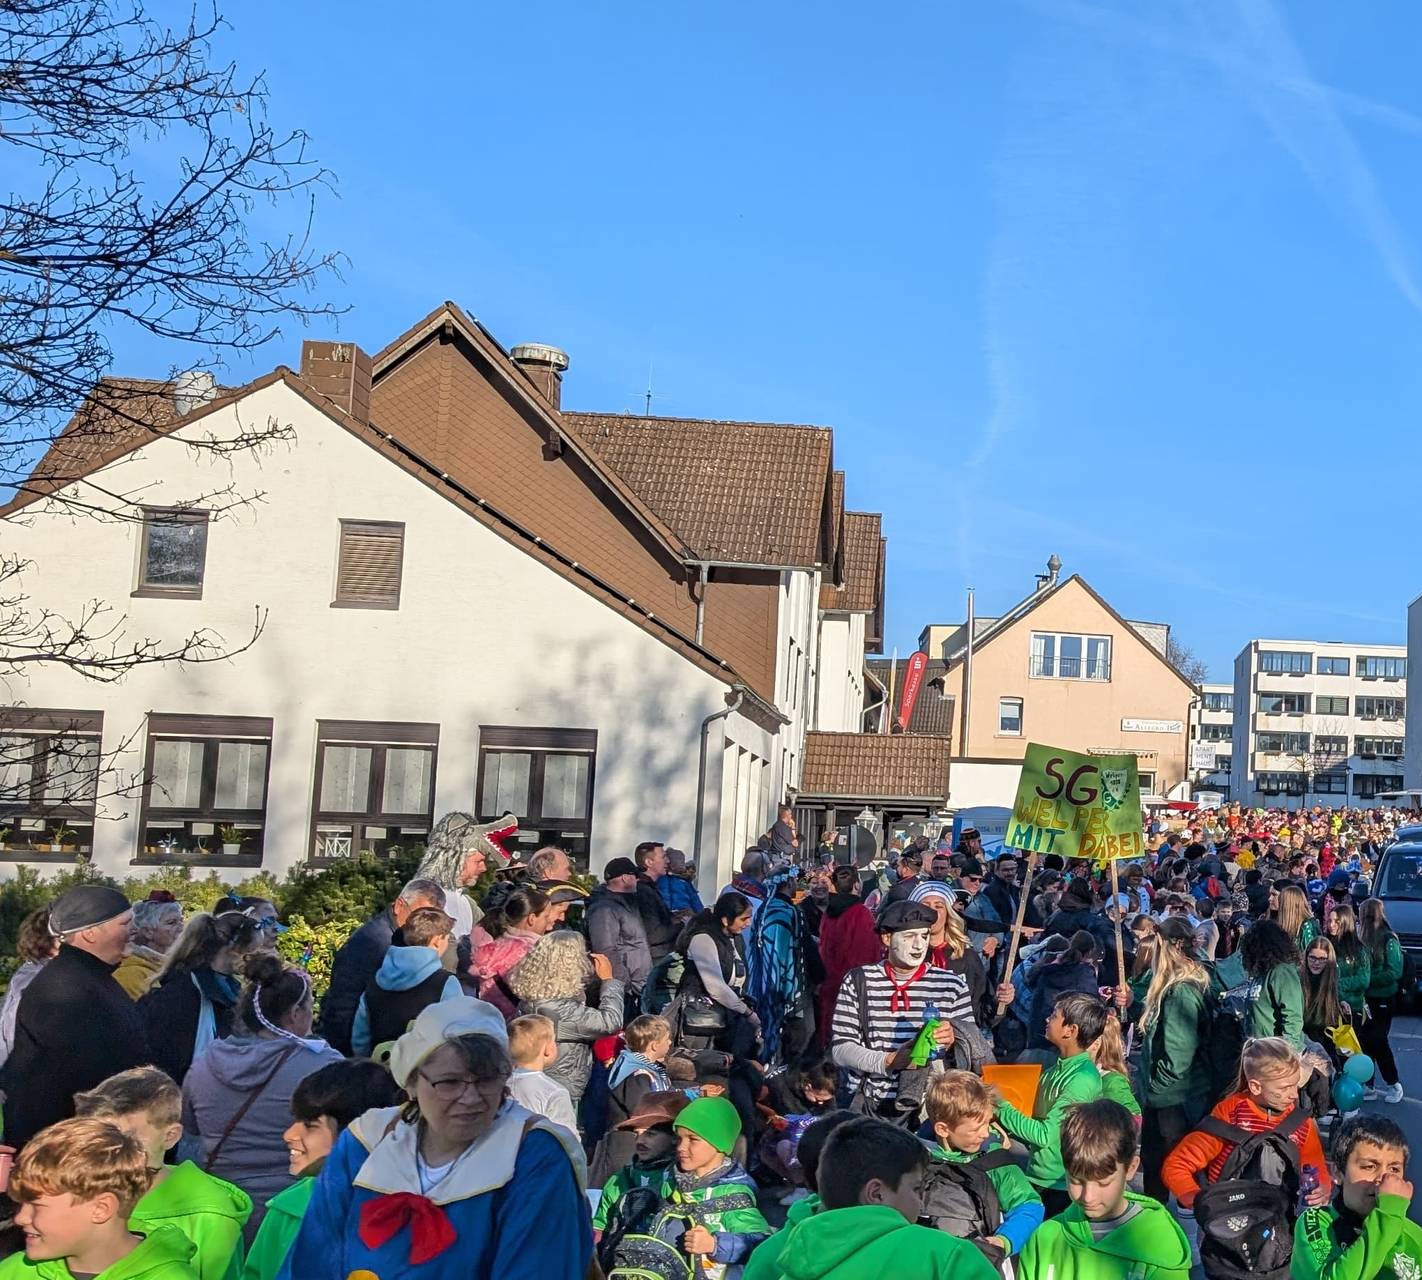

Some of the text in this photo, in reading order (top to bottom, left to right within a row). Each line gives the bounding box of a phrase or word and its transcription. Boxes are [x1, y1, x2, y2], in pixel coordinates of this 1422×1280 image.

[1035, 757, 1099, 806] SG
[1011, 823, 1066, 853] MIT
[1077, 832, 1140, 859] DABEI
[1228, 1193, 1245, 1202] JAKO
